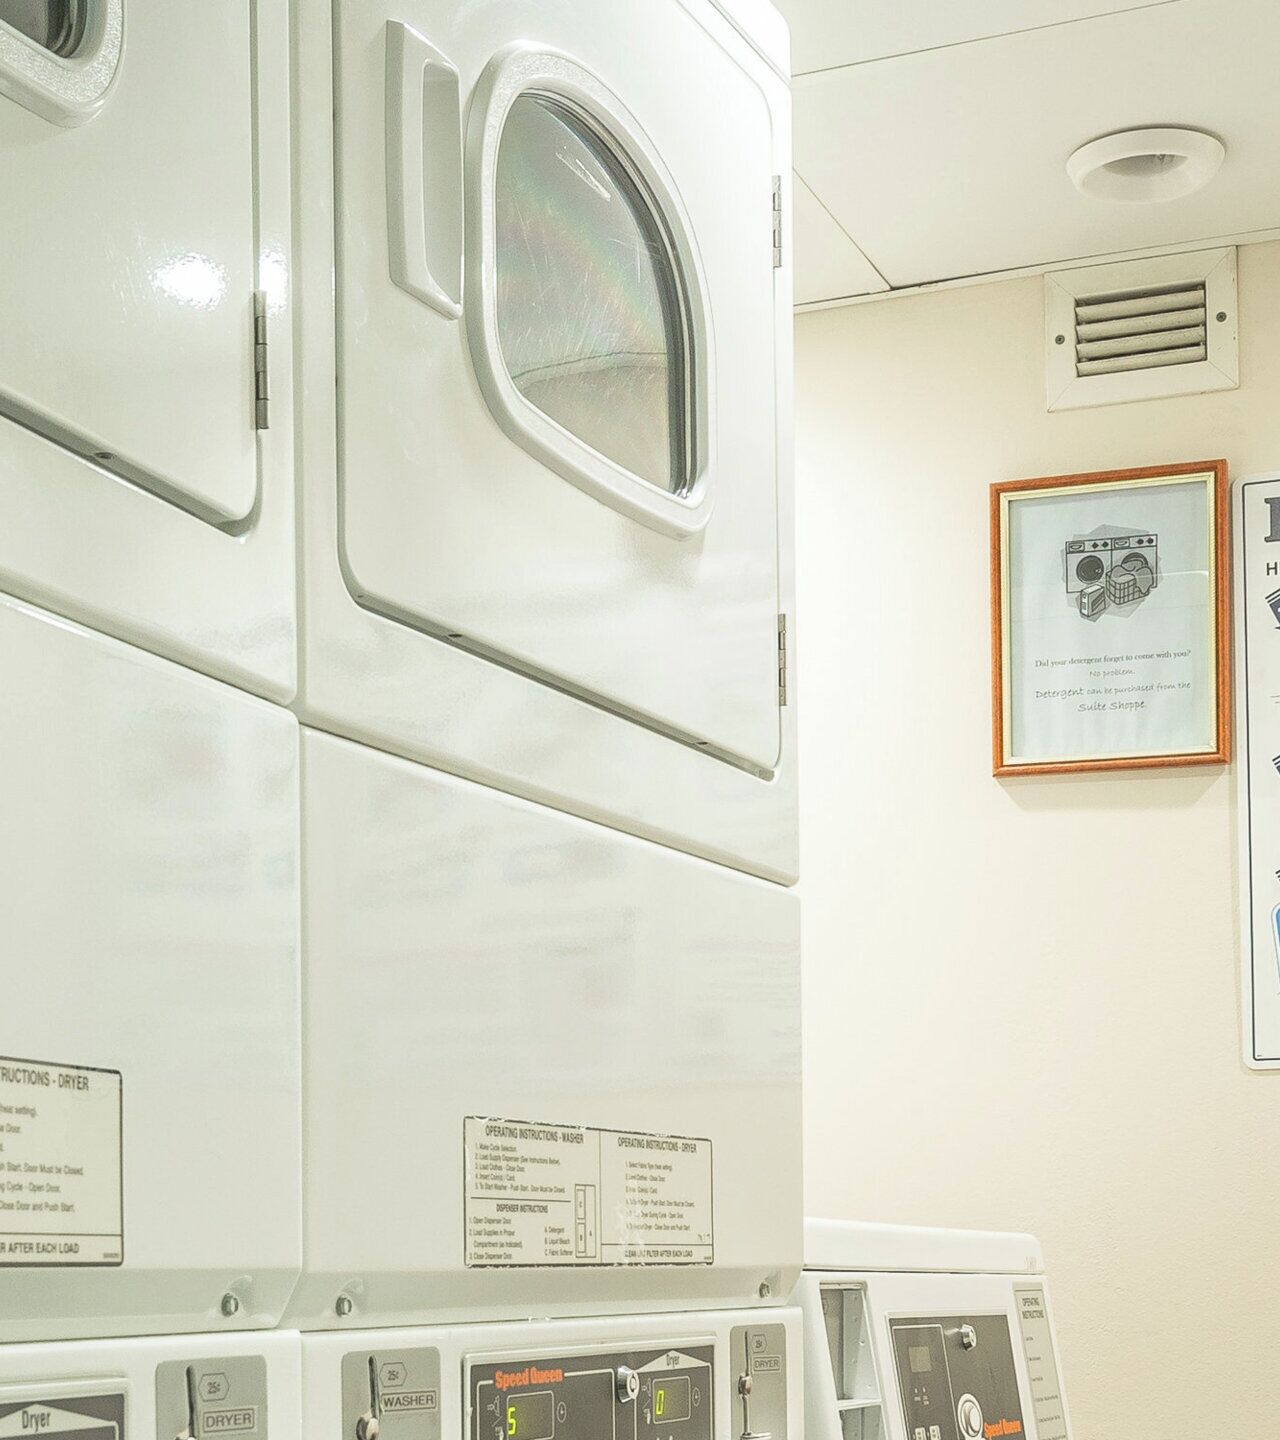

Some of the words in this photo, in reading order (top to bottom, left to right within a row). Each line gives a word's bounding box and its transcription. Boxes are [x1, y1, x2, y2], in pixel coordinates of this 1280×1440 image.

[1034, 659, 1049, 668] Did
[1050, 659, 1066, 668] your
[1068, 655, 1102, 667] detergent
[1102, 654, 1124, 665] forget
[1125, 653, 1133, 661] to
[1134, 653, 1155, 661] come
[1155, 650, 1172, 659] with
[1172, 649, 1194, 660] you?
[1077, 702, 1106, 712] Suite
[1109, 700, 1148, 712] Shoppe
[57, 1073, 89, 1091] DRYER
[484, 1125, 518, 1139] OPERATING
[518, 1128, 558, 1142] INSTRUCTIONS
[561, 1132, 584, 1144] WASHER
[617, 1137, 645, 1149] OPERATING
[645, 1139, 678, 1152] INSTRUCTIONS
[681, 1142, 696, 1153] DRYER
[7, 1241, 34, 1254] AFTER
[35, 1241, 57, 1254] EACH
[58, 1242, 79, 1254] LOAD
[666, 1354, 680, 1367] Dryer
[754, 1358, 780, 1370] DRYER
[495, 1369, 530, 1391] Speed
[530, 1367, 563, 1385] Queen
[384, 1393, 435, 1408] WASHER
[656, 1389, 665, 1415] 0
[22, 1410, 51, 1432] Dryer
[205, 1412, 252, 1428] DRYER
[507, 1406, 517, 1435] 5
